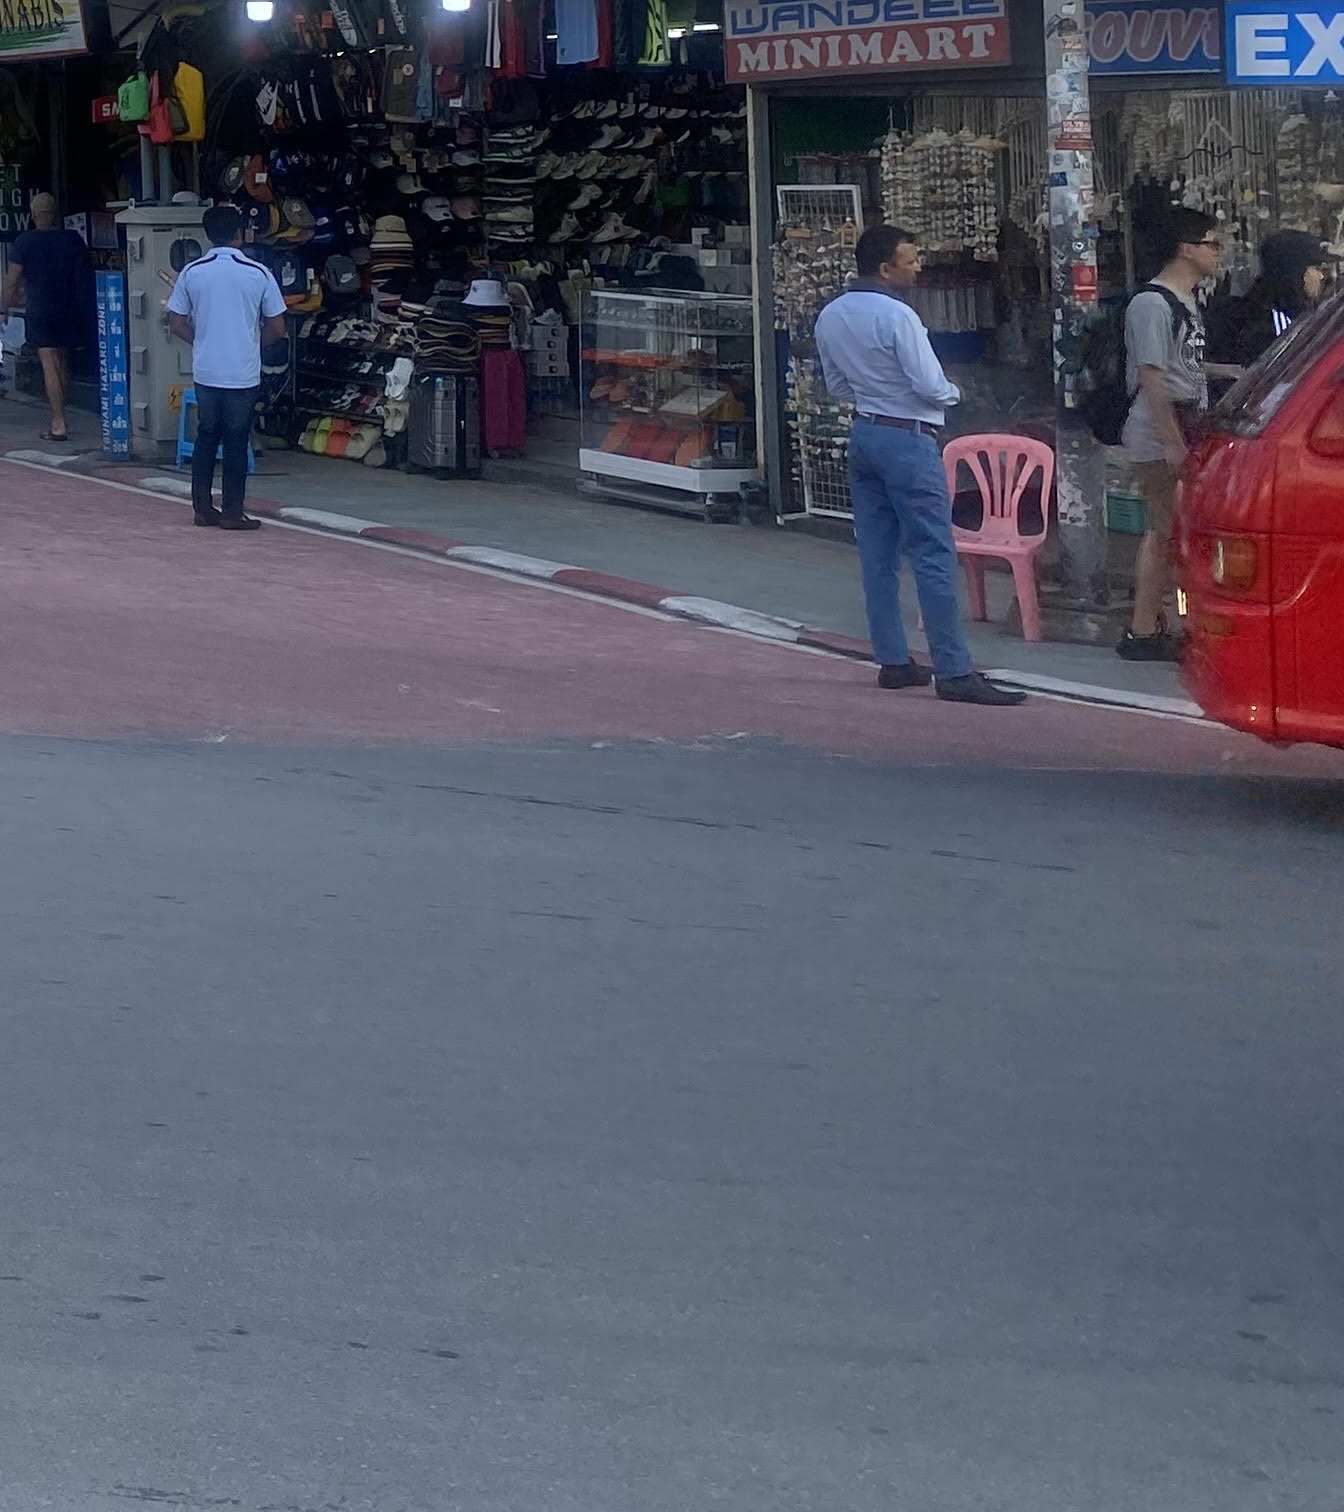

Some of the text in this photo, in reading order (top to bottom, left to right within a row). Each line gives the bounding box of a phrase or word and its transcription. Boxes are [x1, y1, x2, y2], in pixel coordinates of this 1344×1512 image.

[737, 22, 996, 74] MINIMART
[1235, 13, 1344, 77] EX
[96, 301, 111, 453] TSUNAMI HAZARD ZONE
